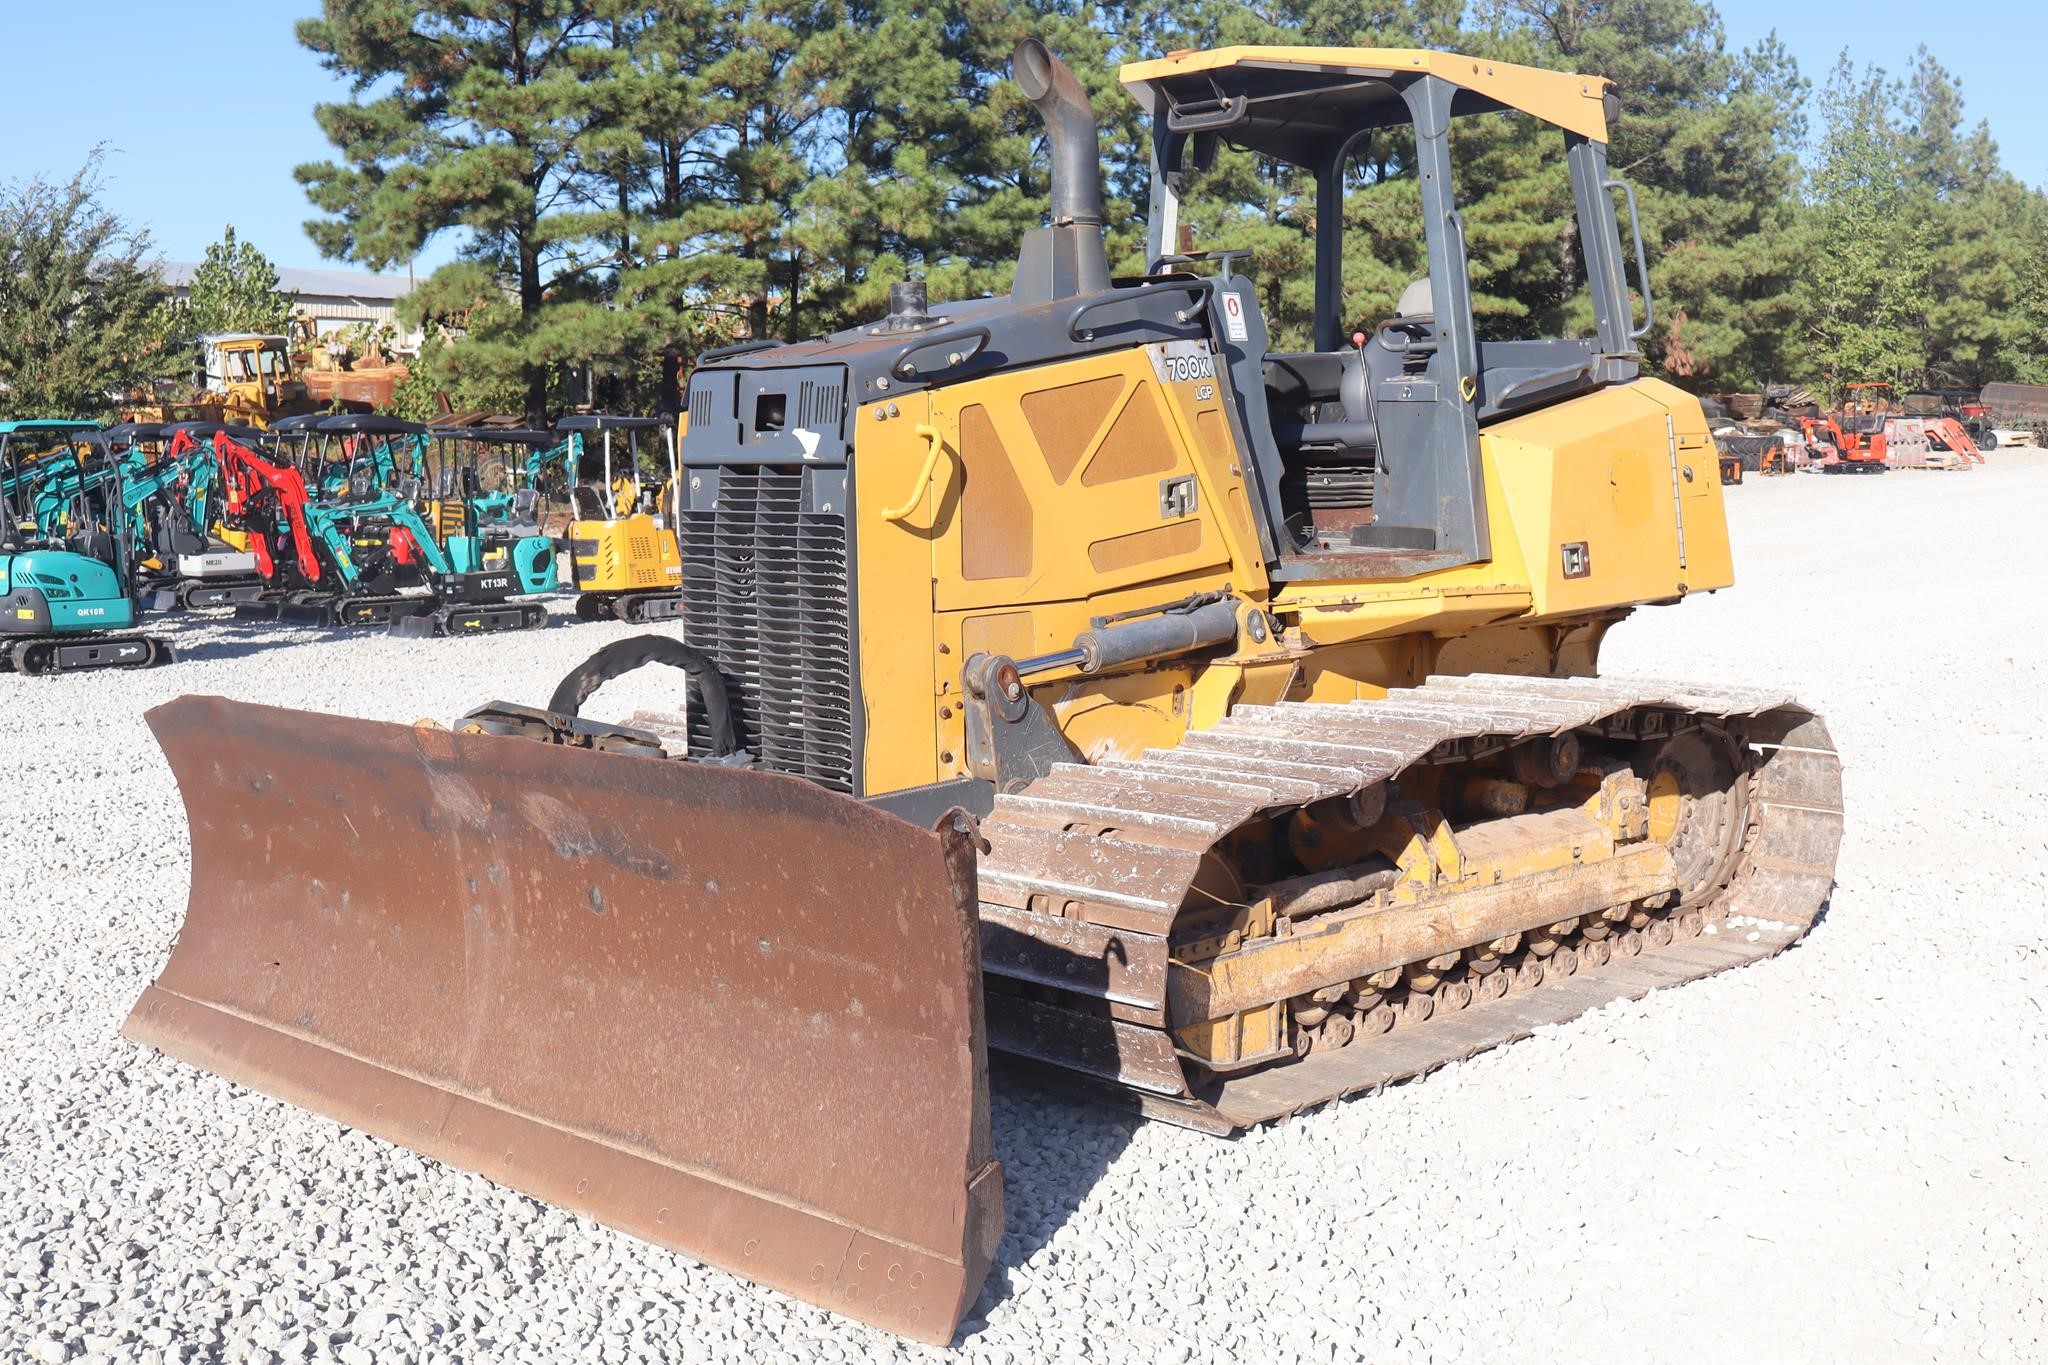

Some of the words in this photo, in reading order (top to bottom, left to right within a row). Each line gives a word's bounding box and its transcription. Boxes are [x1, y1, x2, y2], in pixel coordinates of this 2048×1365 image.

[1166, 355, 1211, 381] 700K
[1195, 386, 1213, 400] LGP
[481, 578, 508, 588] KT13R
[77, 608, 105, 616] QK16R
